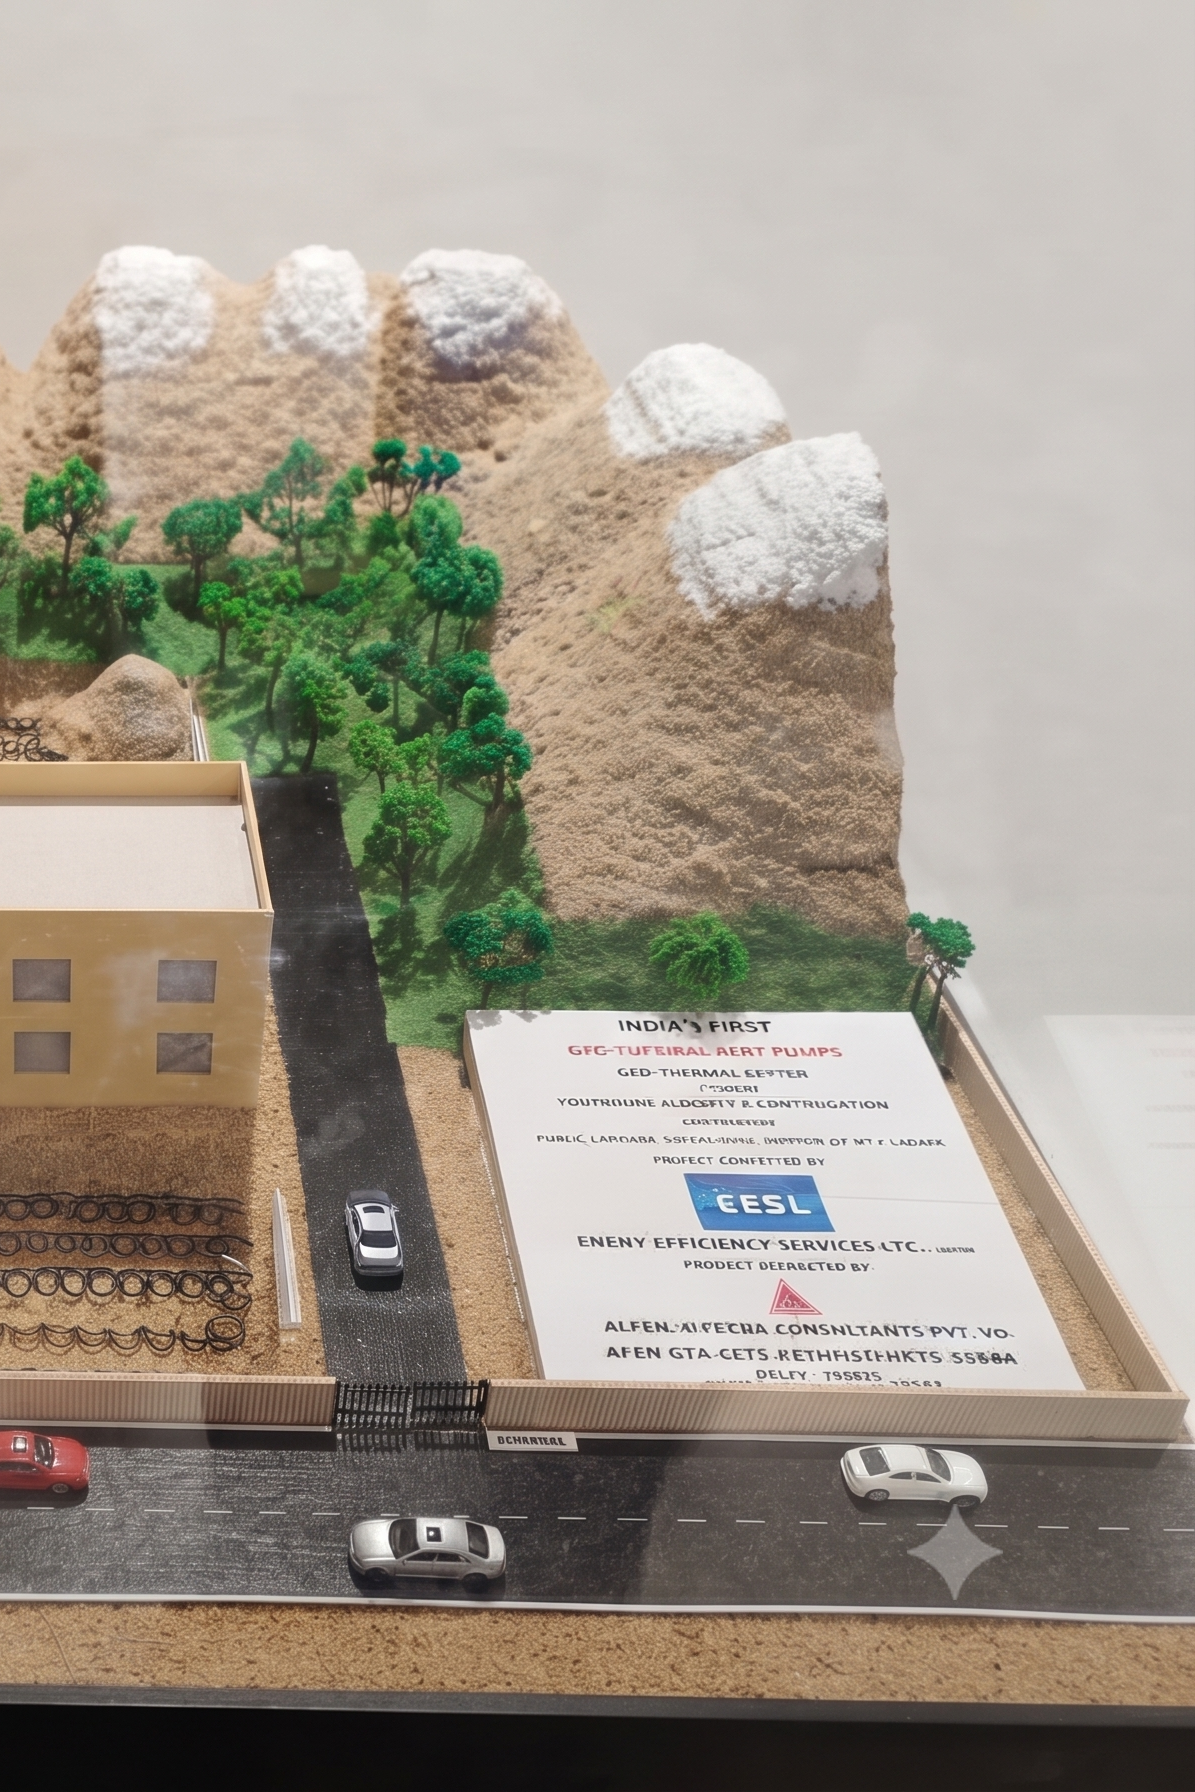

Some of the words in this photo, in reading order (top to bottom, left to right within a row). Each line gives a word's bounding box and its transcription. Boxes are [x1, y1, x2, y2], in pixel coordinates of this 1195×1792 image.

[709, 1020, 772, 1033] FIRST
[716, 1046, 765, 1057] AERT
[772, 1046, 843, 1058] PUMPS
[536, 1134, 587, 1144] PUBLIC
[829, 1137, 849, 1147] OF
[653, 1156, 714, 1165] PROFECT
[719, 1156, 801, 1166] CONFETTED
[807, 1157, 825, 1166] BY
[716, 1194, 812, 1214] EESL
[577, 1235, 646, 1249] ENENY
[654, 1236, 771, 1250] EFFICIENCY
[778, 1239, 875, 1252] SERVICES
[683, 1260, 754, 1270] PRODECT
[606, 1346, 662, 1359] AFEN
